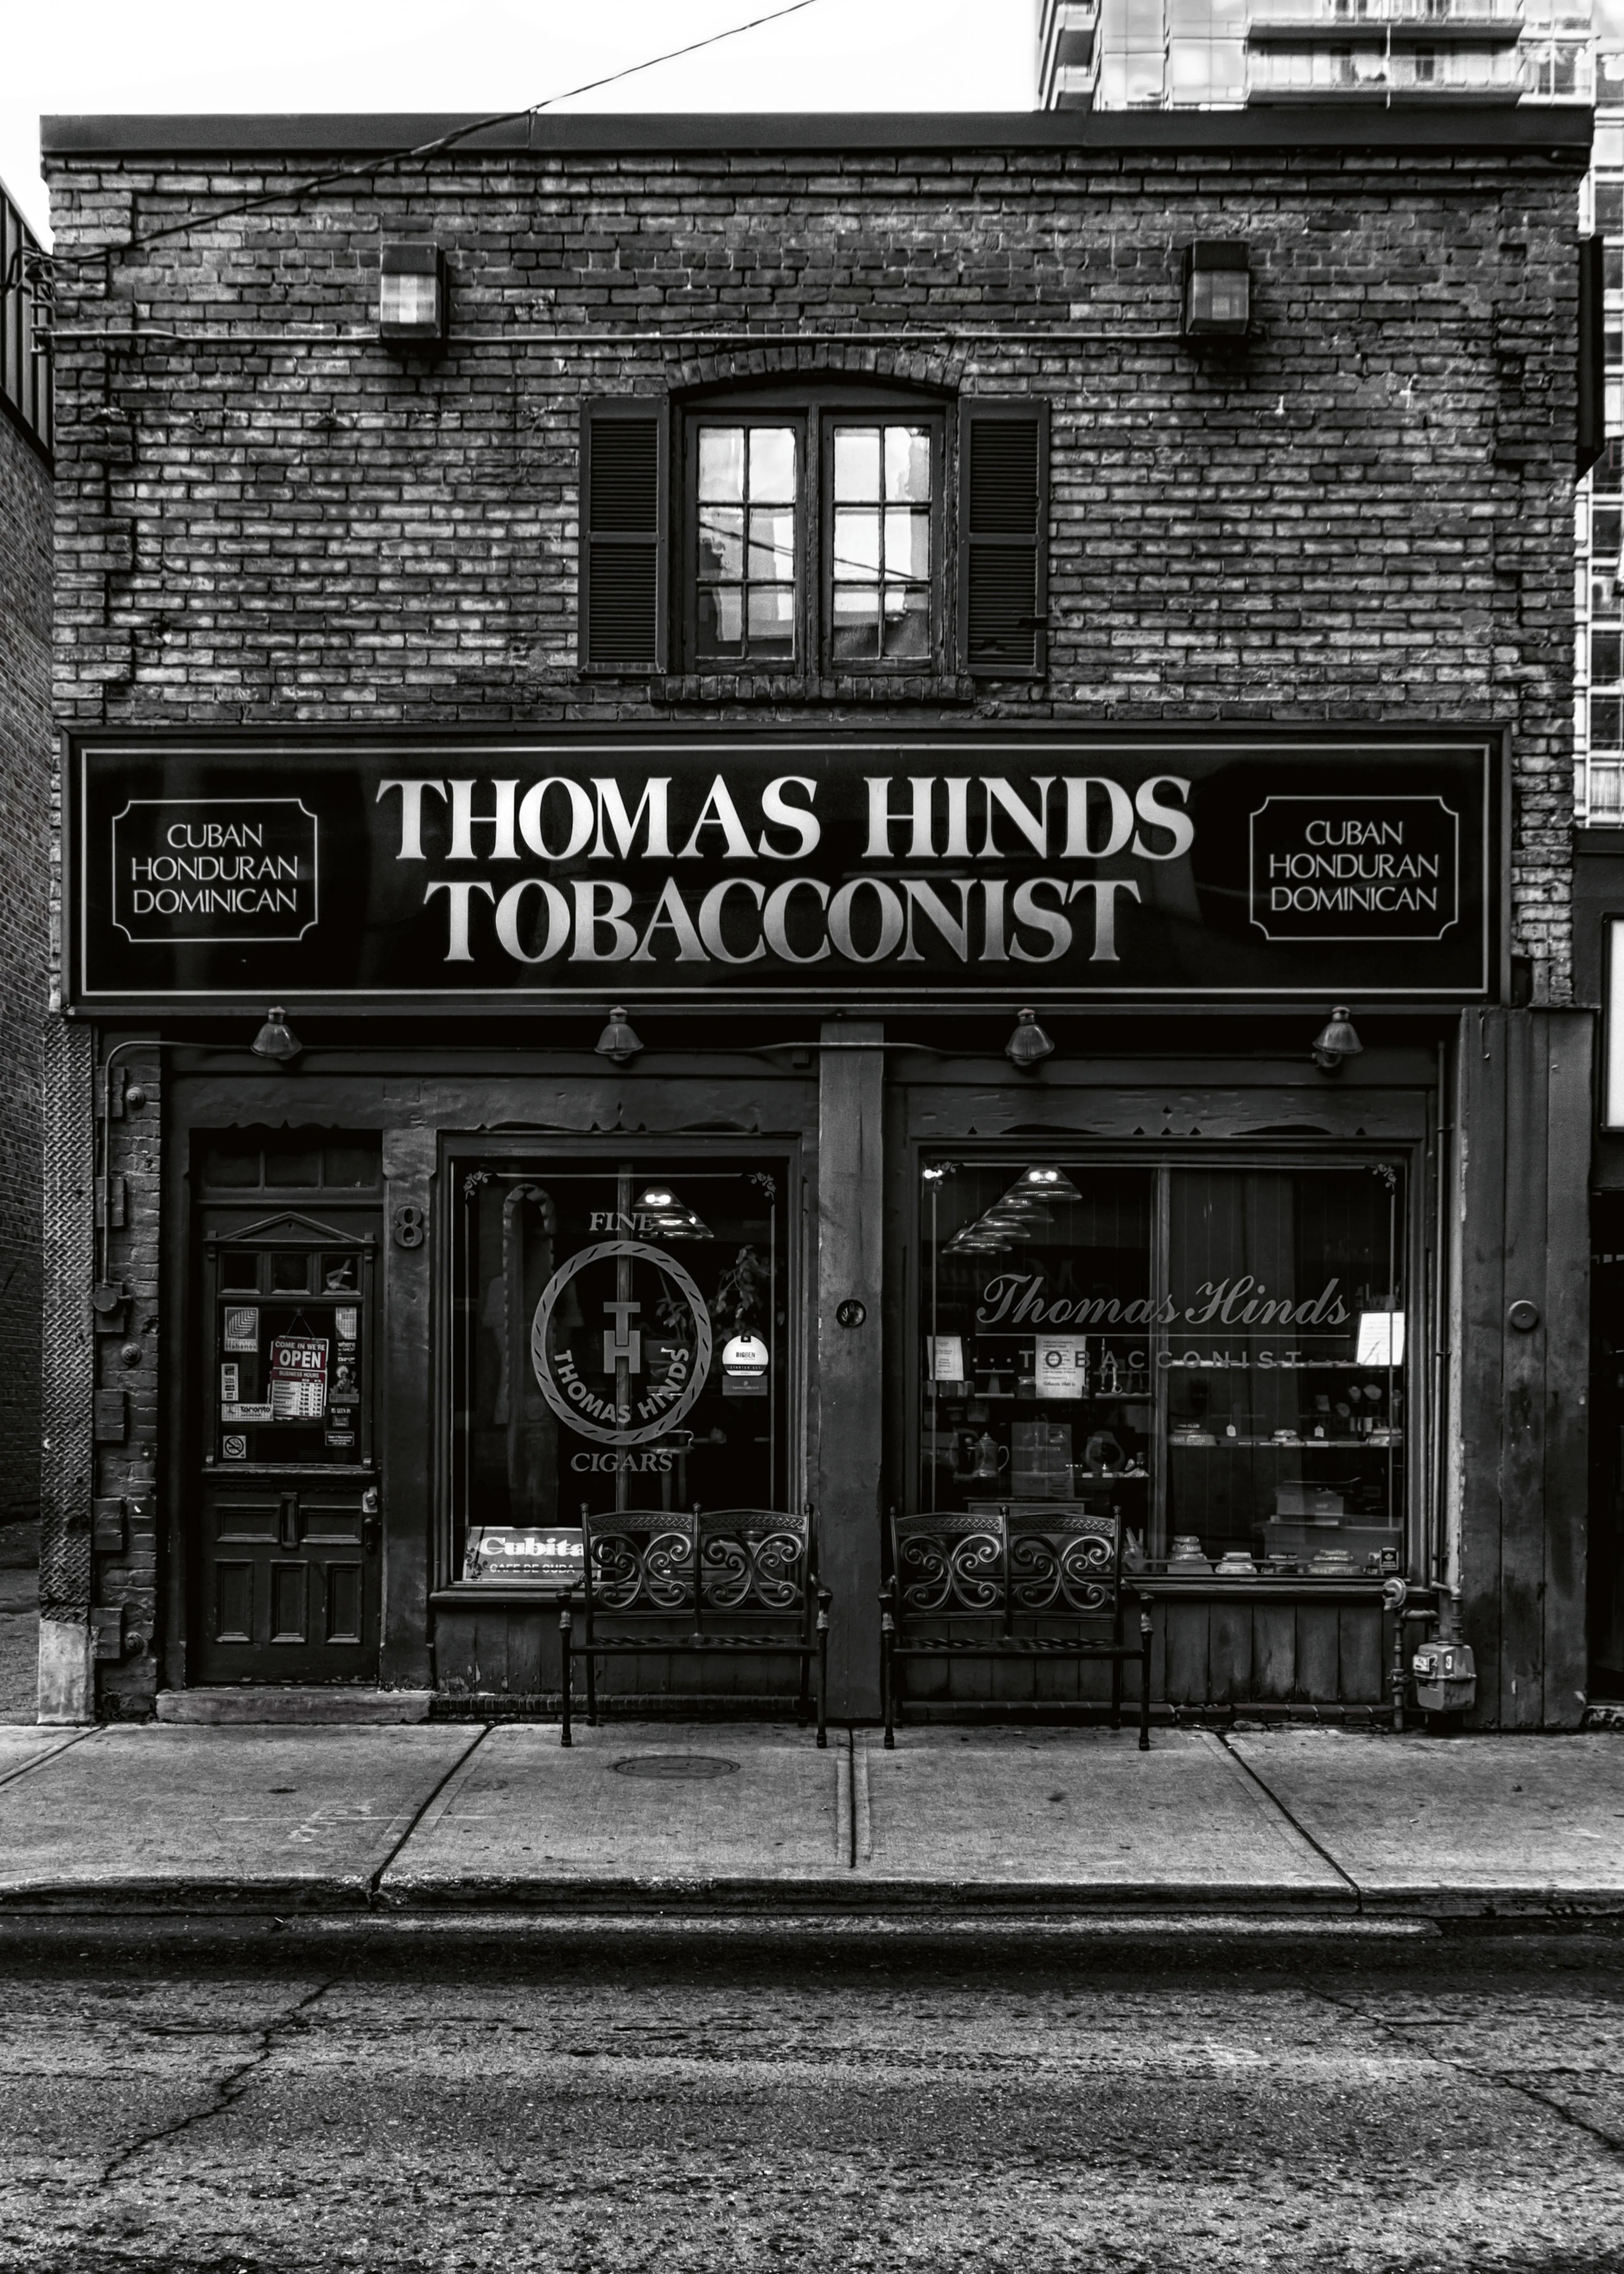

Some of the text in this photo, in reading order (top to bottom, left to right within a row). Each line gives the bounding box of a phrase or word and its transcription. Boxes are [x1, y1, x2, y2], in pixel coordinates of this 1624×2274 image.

[375, 774, 1194, 861] THOMAS HINDS
[167, 823, 262, 849] CUBAN
[1306, 821, 1402, 845] CUBAN
[132, 855, 298, 882] HONDURAN
[1270, 853, 1438, 879] HONDURAN
[134, 888, 296, 914] DOMINICAN
[1271, 886, 1437, 912] DOMINICAN
[423, 877, 1141, 963] TOBACCONIST
[395, 1205, 424, 1247] 8
[589, 1212, 655, 1231] FINE
[976, 1273, 1181, 1324] Thomas
[1185, 1275, 1351, 1325] Hinds
[279, 1348, 322, 1368] OPEN
[307, 1343, 326, 1351] WE'RE
[1018, 1350, 1301, 1369] TOBACCONIST
[554, 1348, 690, 1423] THOMAS HINDS
[571, 1453, 673, 1472] CIGARS
[478, 1536, 584, 1557] Cubita
